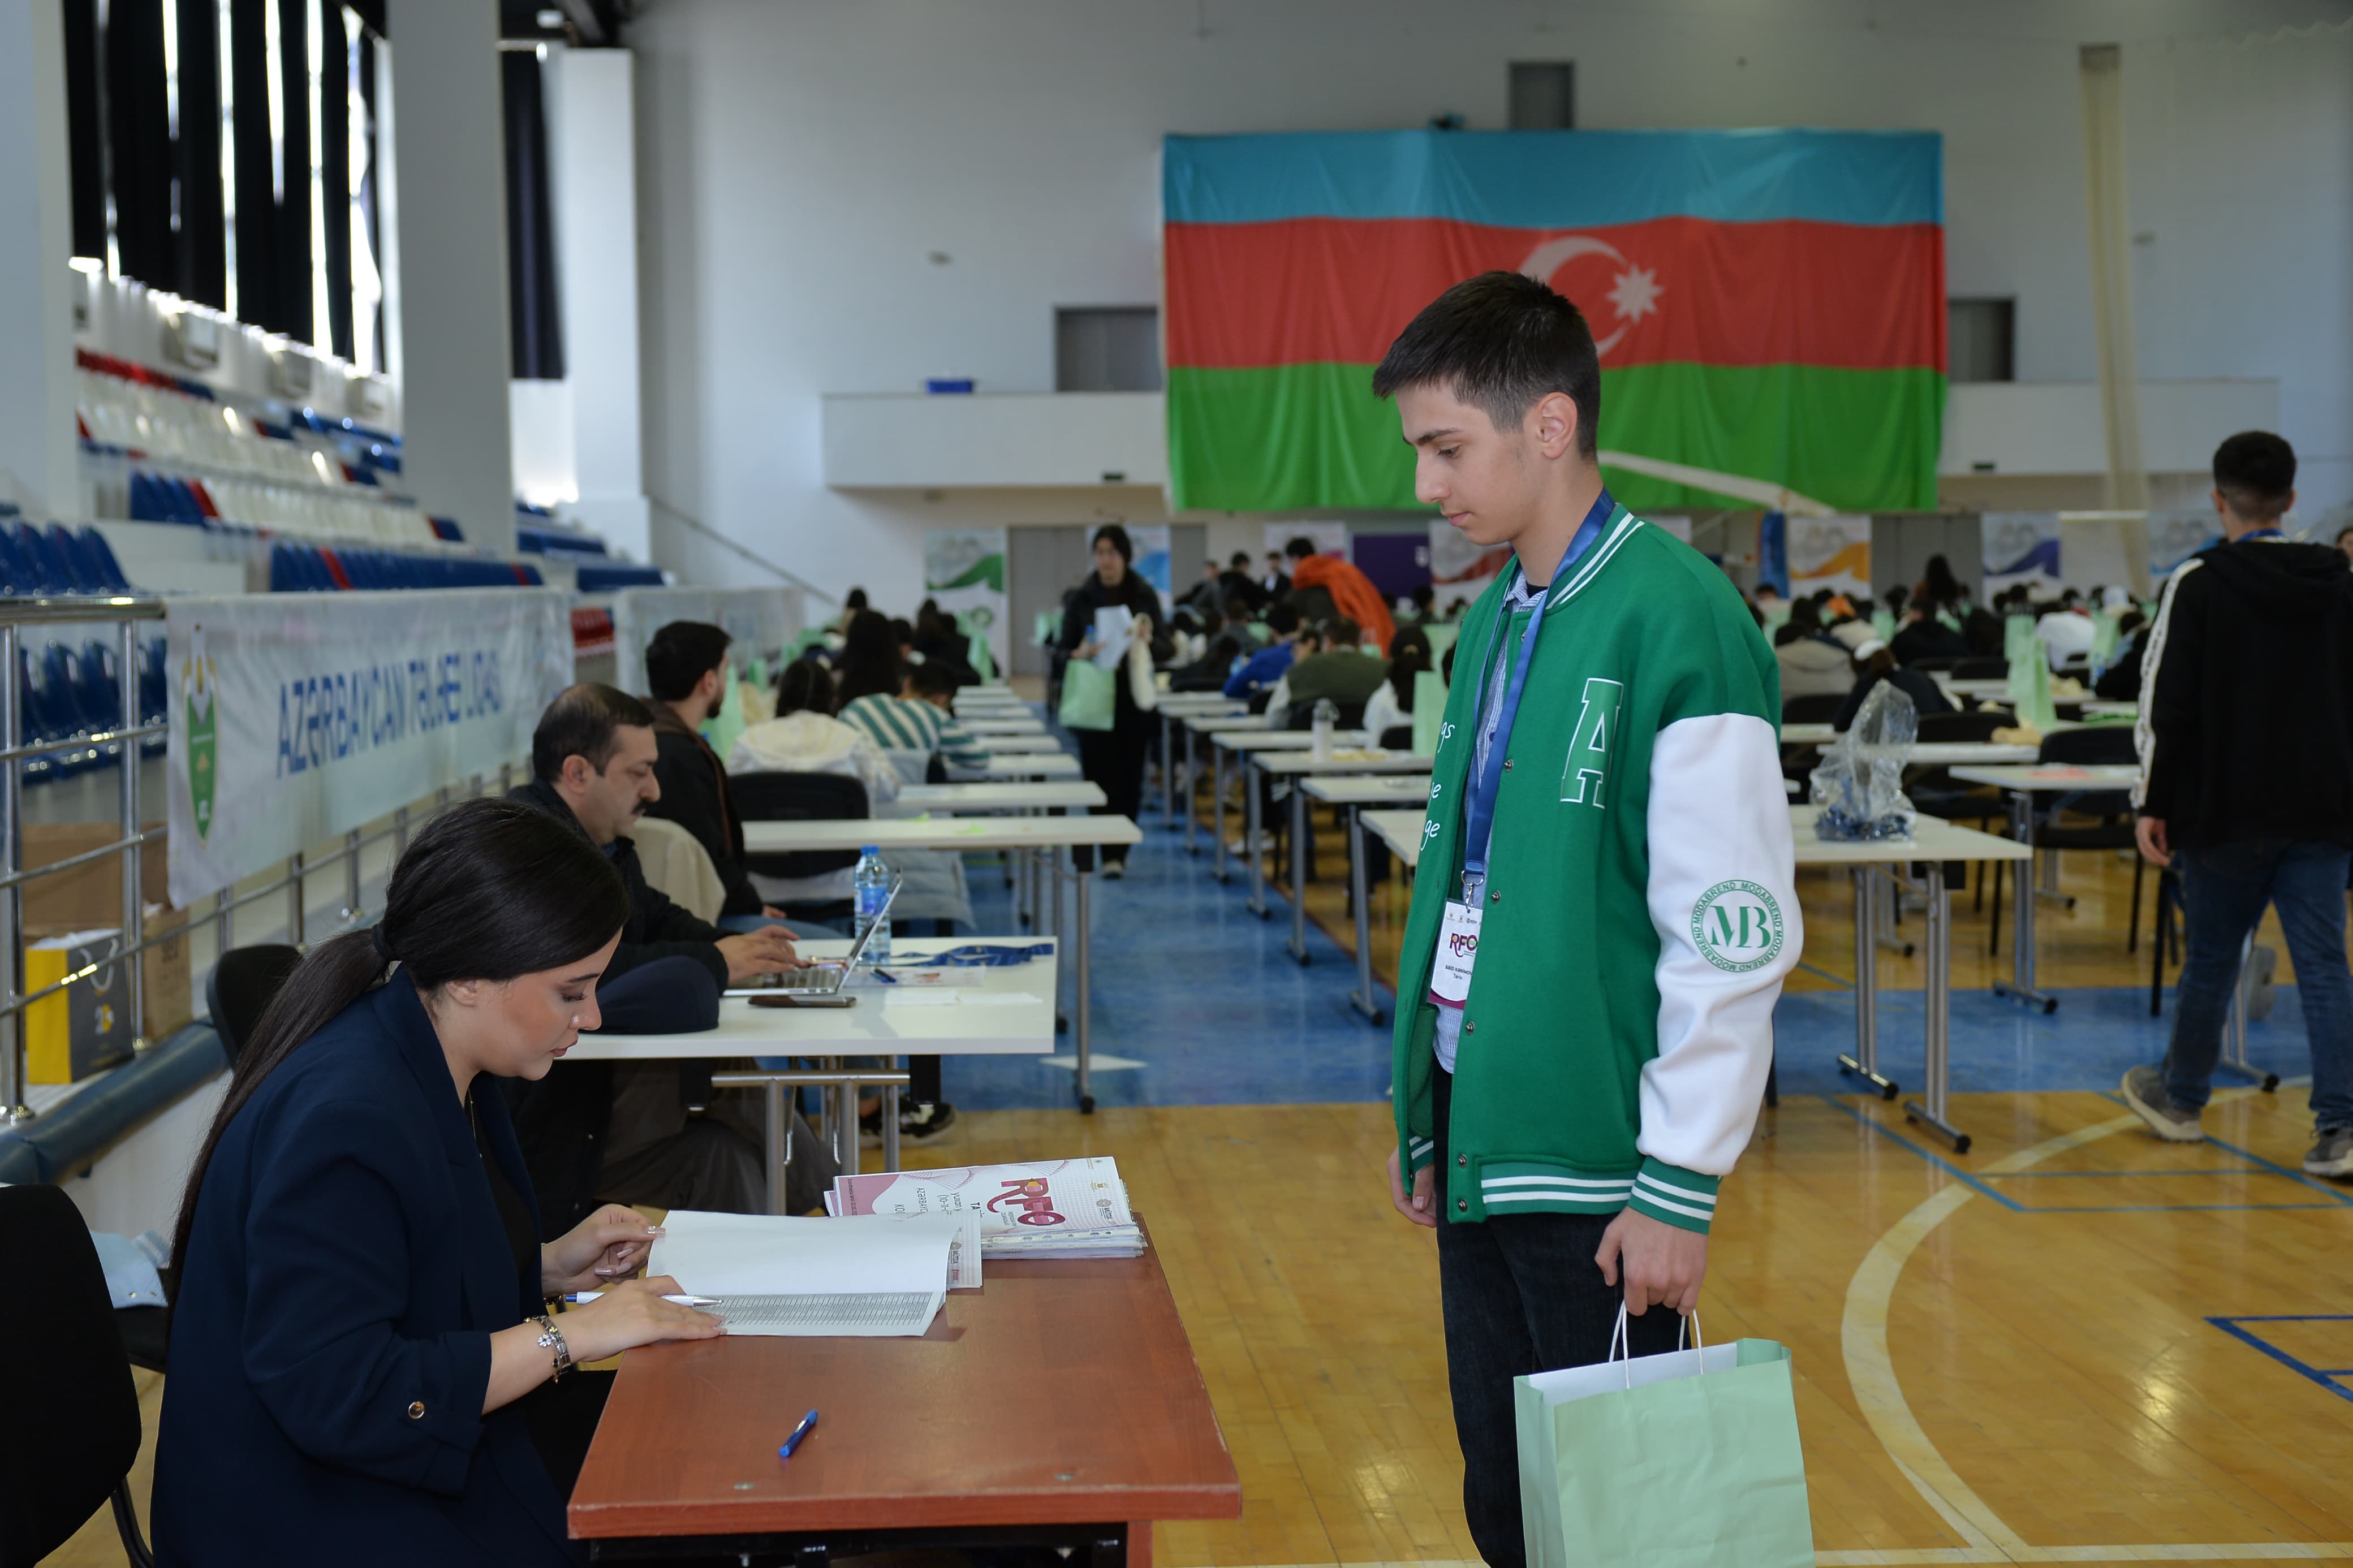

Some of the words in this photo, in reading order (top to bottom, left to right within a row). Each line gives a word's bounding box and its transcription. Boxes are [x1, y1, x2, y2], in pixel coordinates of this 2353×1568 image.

[1560, 677, 1624, 809] A
[1693, 882, 1736, 924] MODABREND
[1450, 933, 1478, 958] RFO
[1710, 906, 1771, 948] MB
[987, 1178, 1066, 1226] RFO
